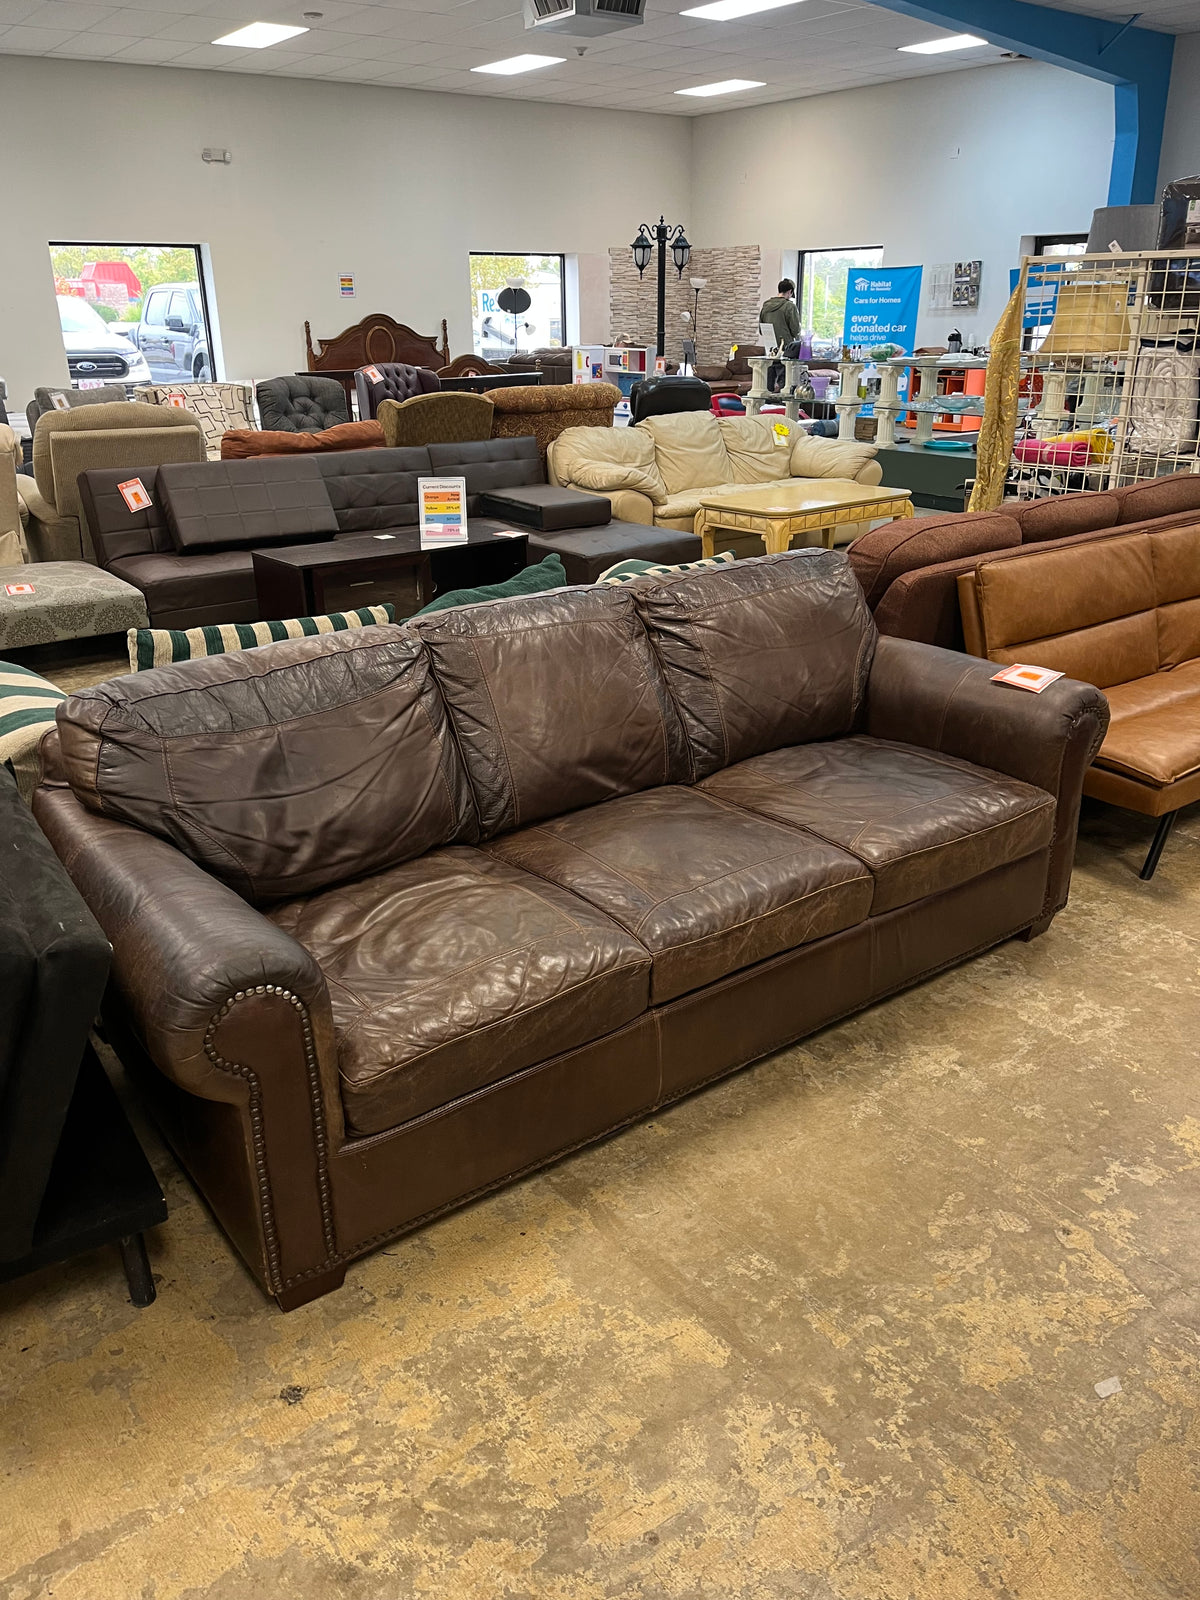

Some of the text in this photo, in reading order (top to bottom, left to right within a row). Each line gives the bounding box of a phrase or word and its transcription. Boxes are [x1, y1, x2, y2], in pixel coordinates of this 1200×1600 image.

[851, 315, 878, 324] every
[850, 323, 907, 333] donated car
[869, 333, 886, 341] drive
